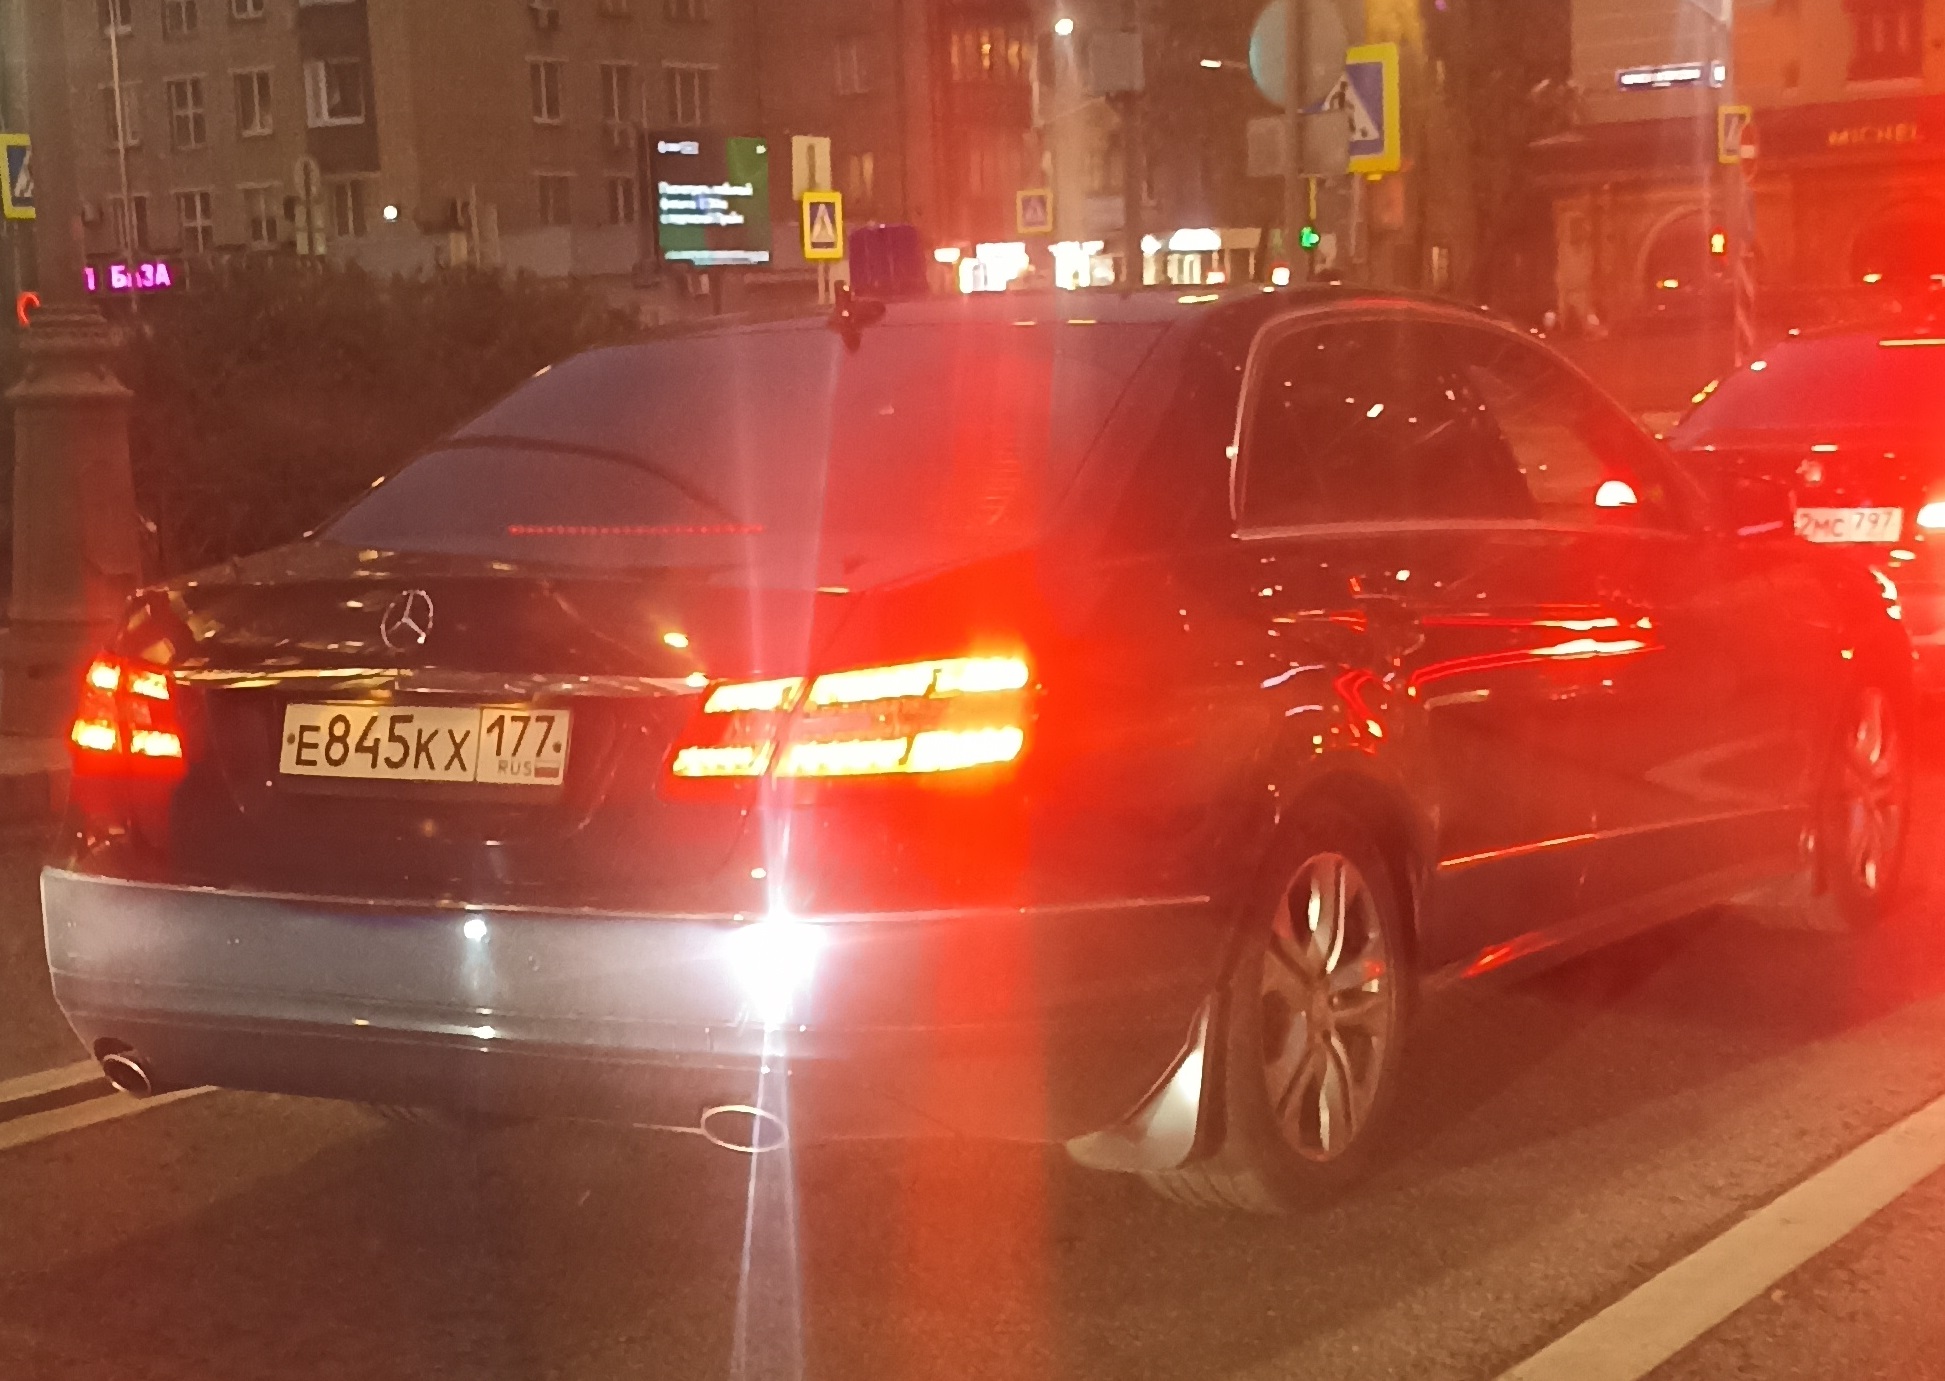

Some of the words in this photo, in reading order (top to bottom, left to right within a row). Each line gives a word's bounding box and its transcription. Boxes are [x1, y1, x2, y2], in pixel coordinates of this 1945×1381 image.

[1854, 511, 1893, 530] 797
[295, 714, 471, 772] Е845КХ
[486, 715, 555, 758] 177
[497, 759, 532, 776] RUS
